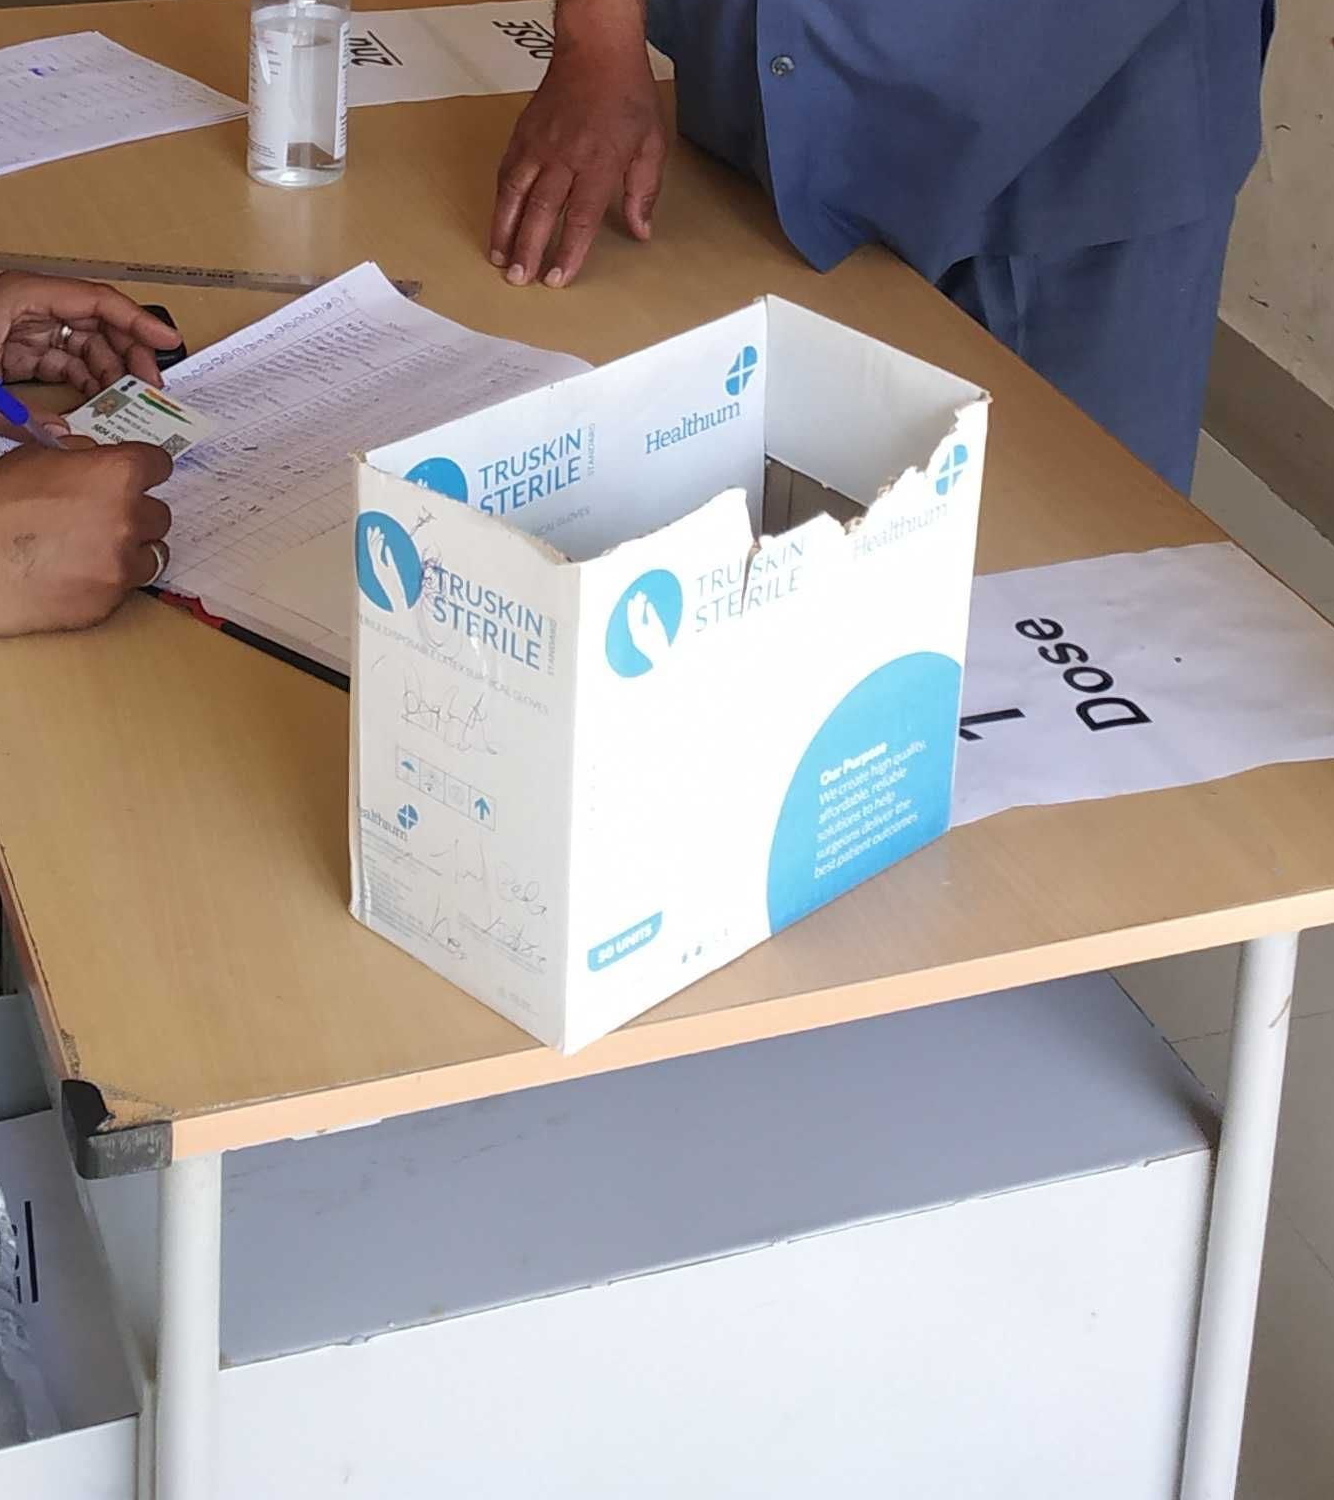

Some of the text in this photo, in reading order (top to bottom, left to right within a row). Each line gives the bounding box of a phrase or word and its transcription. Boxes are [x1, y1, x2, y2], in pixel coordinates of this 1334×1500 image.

[645, 401, 742, 455] Healthium
[478, 428, 582, 489] TRUSKIN
[479, 457, 582, 516] STERILE
[852, 503, 947, 560] Healthium
[696, 540, 805, 597] TRUSKIN
[433, 565, 543, 638] TRUSKIN
[696, 565, 802, 632] STERILE
[433, 596, 541, 670] STERILE
[1016, 616, 1153, 732] Dose
[819, 787, 838, 806] We
[838, 771, 870, 796] create
[870, 757, 893, 778] high
[820, 742, 888, 787] Our Purpose
[871, 767, 908, 794] reliable
[816, 798, 912, 860] surgeons deliver the
[817, 790, 896, 841] solutions to help
[813, 856, 837, 879] best
[836, 838, 872, 868] patient
[615, 923, 653, 955] UNITS
